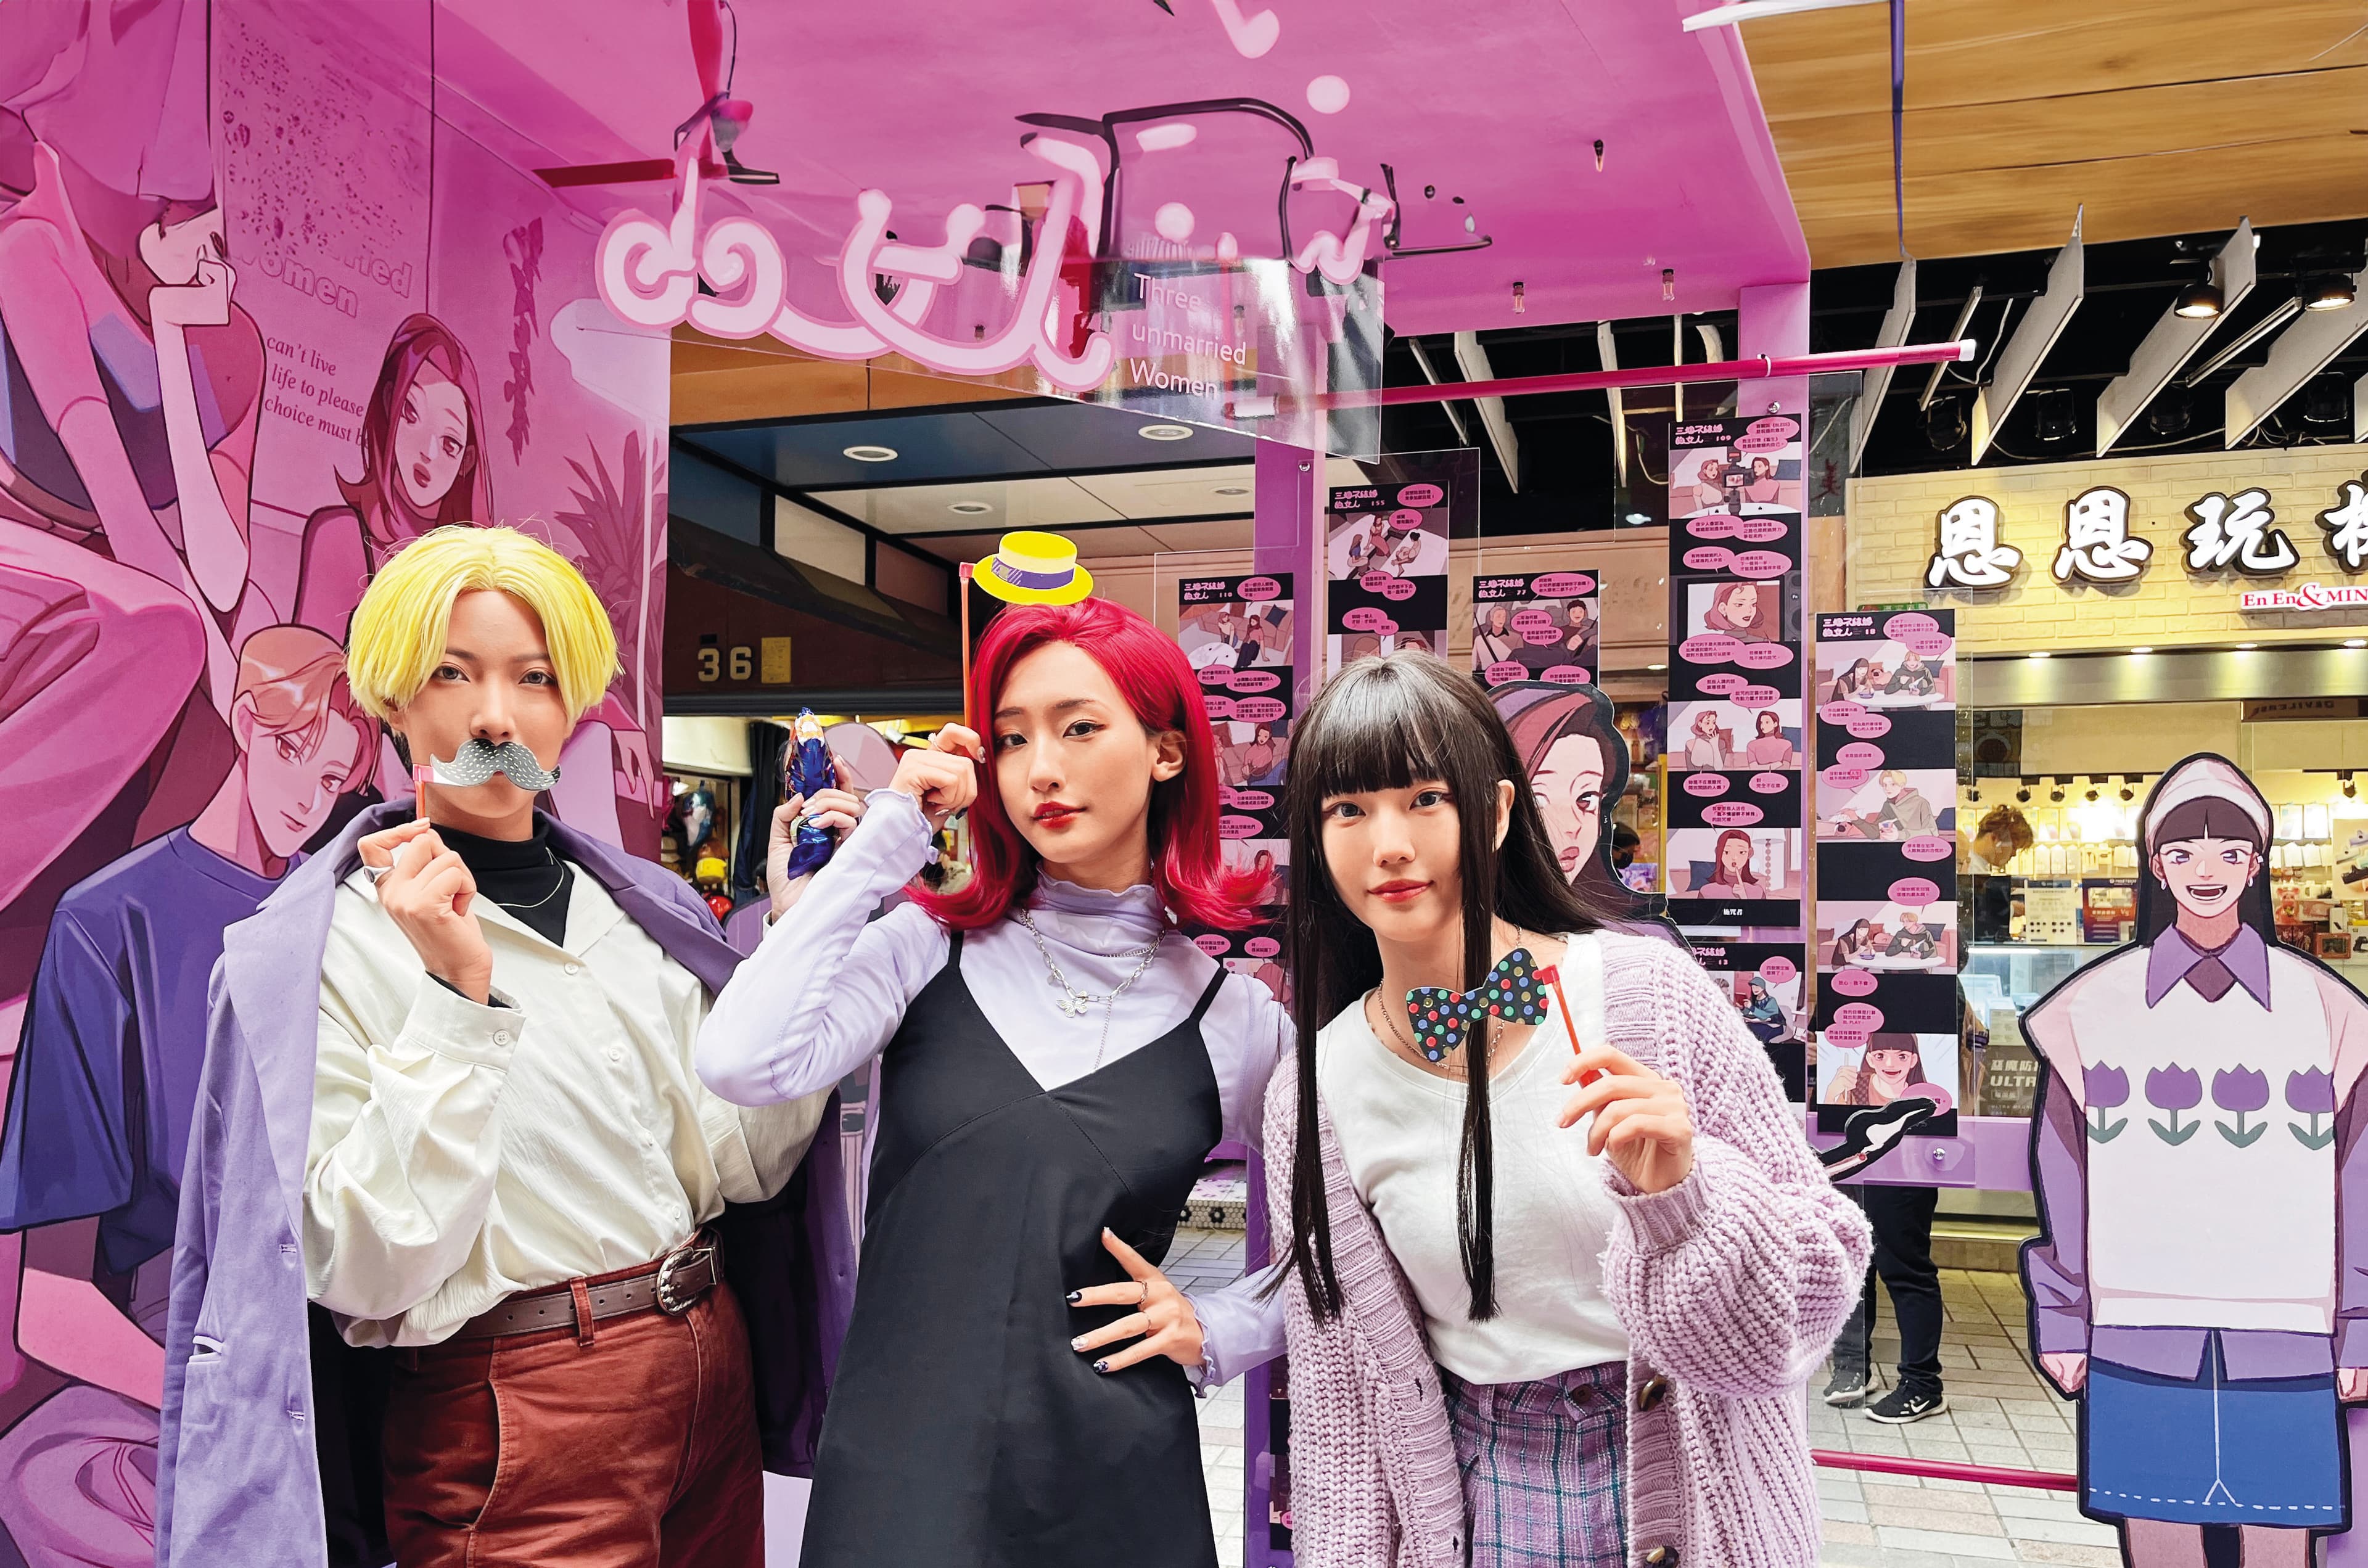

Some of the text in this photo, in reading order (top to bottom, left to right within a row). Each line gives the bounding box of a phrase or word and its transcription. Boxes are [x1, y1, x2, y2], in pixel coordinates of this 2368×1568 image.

[1133, 273, 1201, 309] Three
[310, 349, 336, 376] live
[1132, 324, 1246, 366] unmarried
[271, 363, 364, 417] life to please
[1130, 358, 1218, 401] Women
[265, 395, 314, 427] choice
[318, 419, 352, 442] must
[2243, 594, 2267, 607] En
[2273, 593, 2296, 605] En
[698, 647, 752, 681] 36
